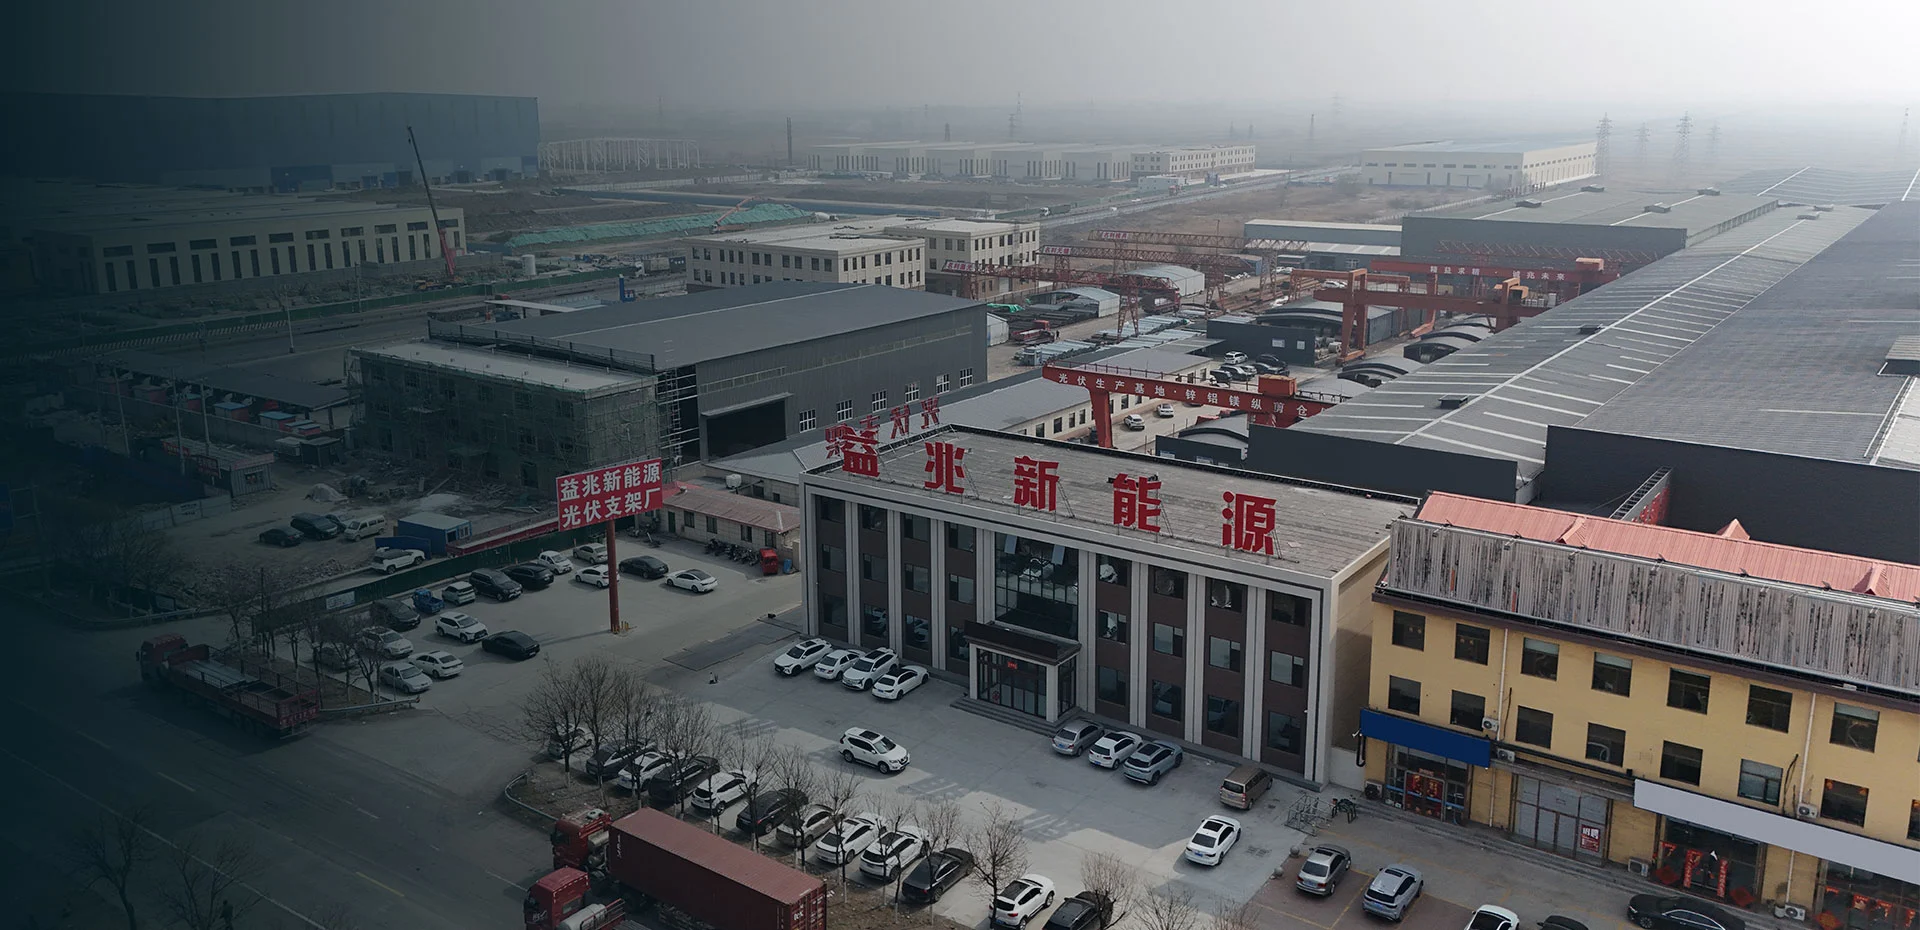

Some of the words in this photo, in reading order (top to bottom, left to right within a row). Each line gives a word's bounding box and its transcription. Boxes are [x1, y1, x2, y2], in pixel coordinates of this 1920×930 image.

[1057, 372, 1326, 417] 光伏生产基地·锌铝镁纵剪仓
[560, 462, 661, 502] 益兆新能源
[842, 425, 1277, 557] 益兆新能源
[563, 487, 661, 528] 光伏支架厂
